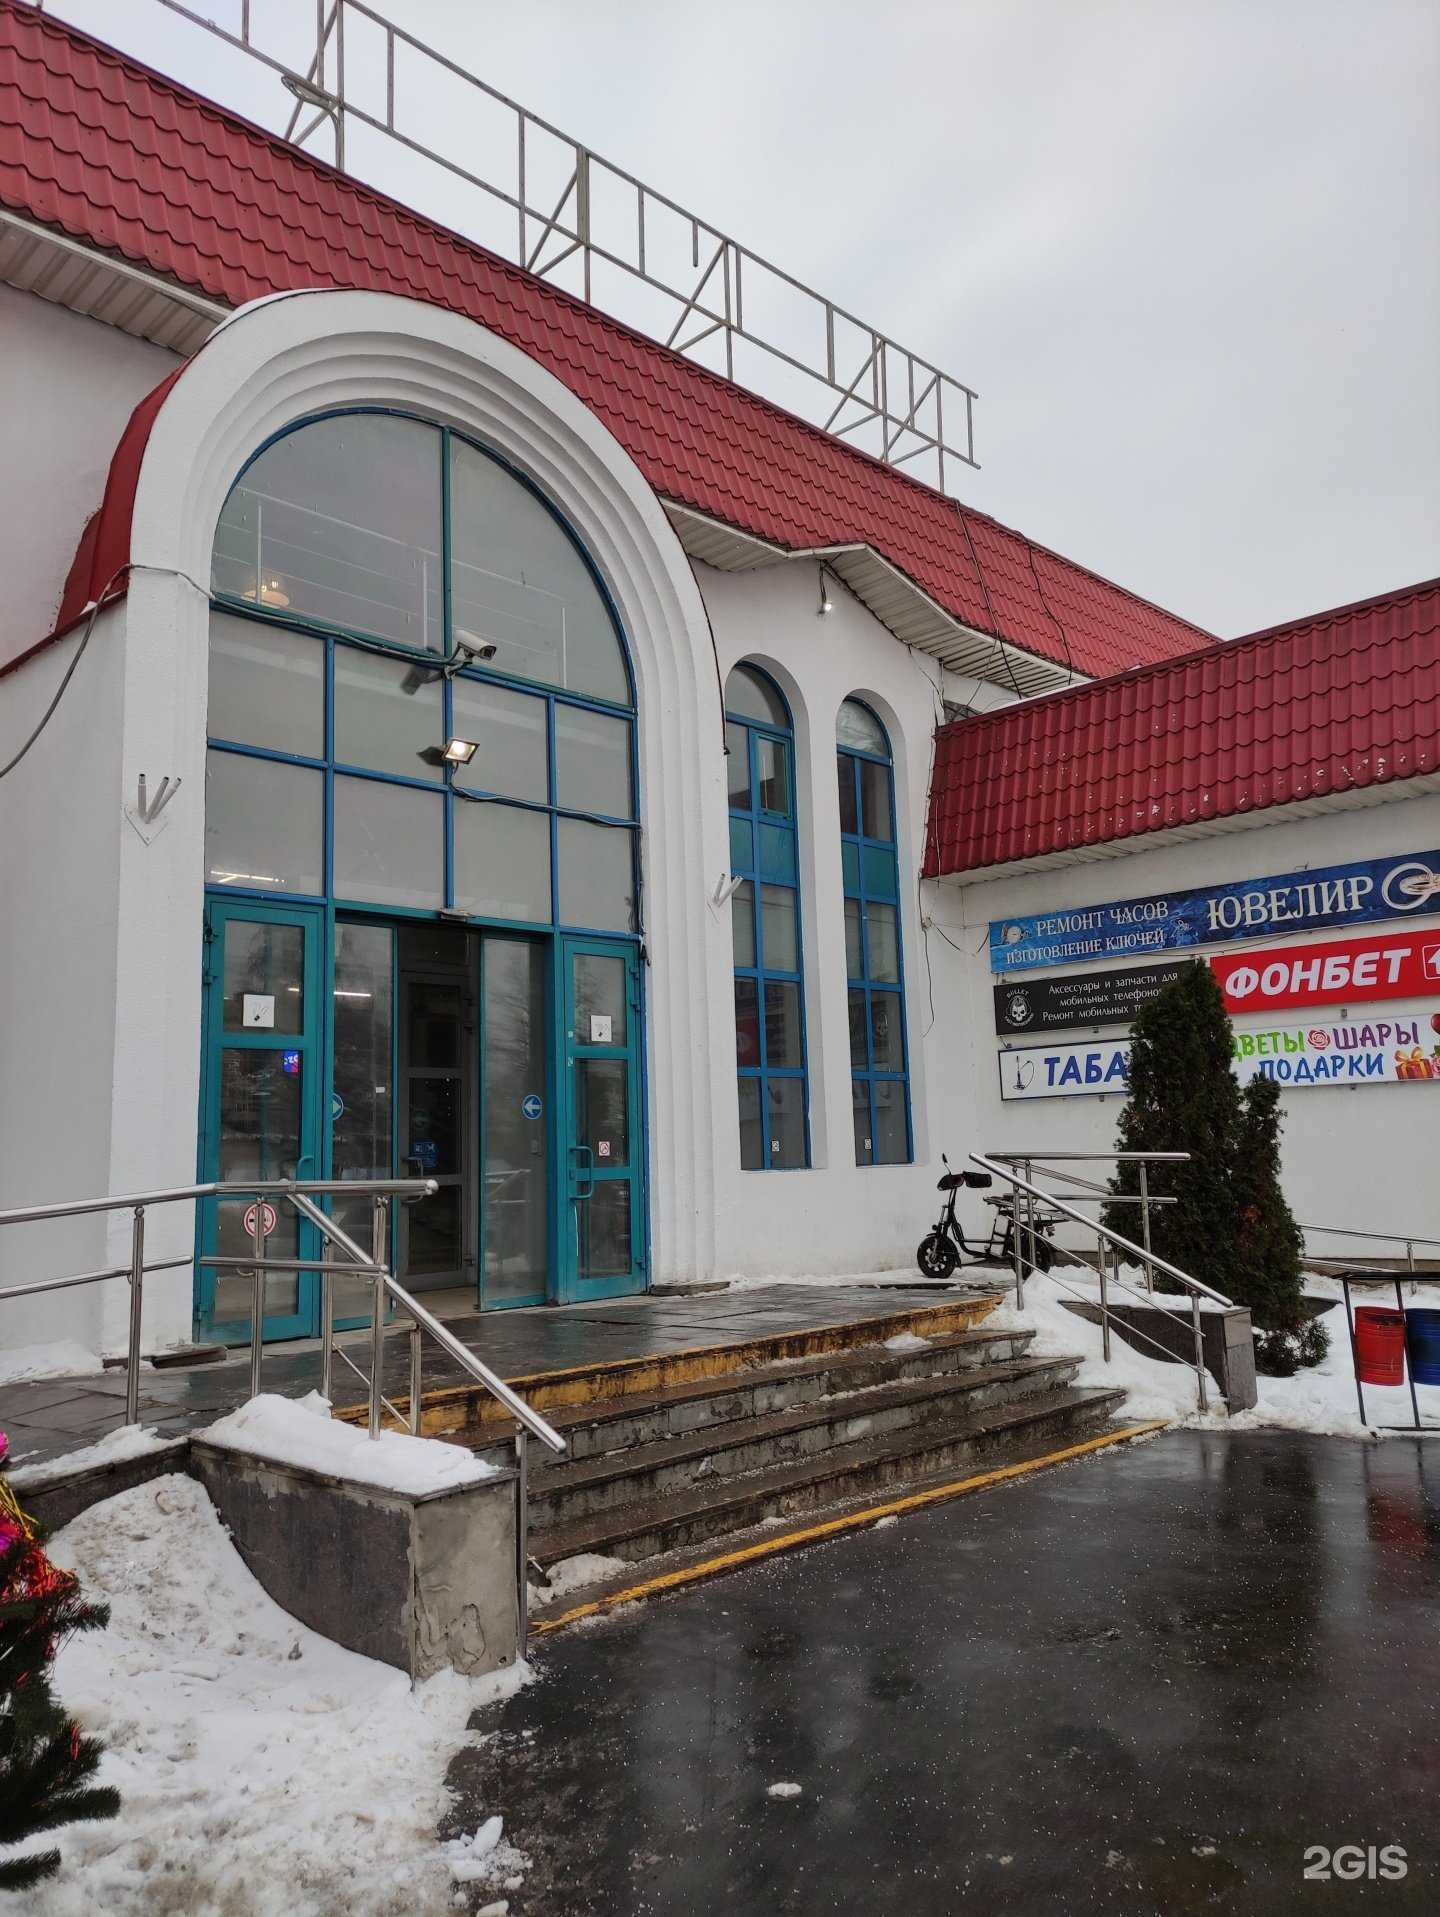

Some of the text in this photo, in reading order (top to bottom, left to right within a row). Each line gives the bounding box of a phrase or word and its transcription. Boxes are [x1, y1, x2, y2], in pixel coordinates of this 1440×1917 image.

[1037, 901, 1169, 937] РЕМОНТ ЧАСОВ
[1207, 876, 1374, 931] ЮВЕЛИР
[1006, 927, 1165, 964] ИЗГОТОВЛЕНИЕ КЛЮЧЕЙ
[1048, 972, 1178, 997] Аксессуары и запчасти для
[1225, 948, 1412, 999] ФОНБЕТ
[1042, 1010, 1074, 1022] Ремонт
[1078, 1005, 1129, 1019] мобильных
[1059, 988, 1162, 1007] мобильных телефоно
[1333, 1022, 1419, 1050] ШАРЫ
[1044, 1052, 1130, 1086] ТАБА
[1259, 1052, 1384, 1083] ПОДАРКИ
